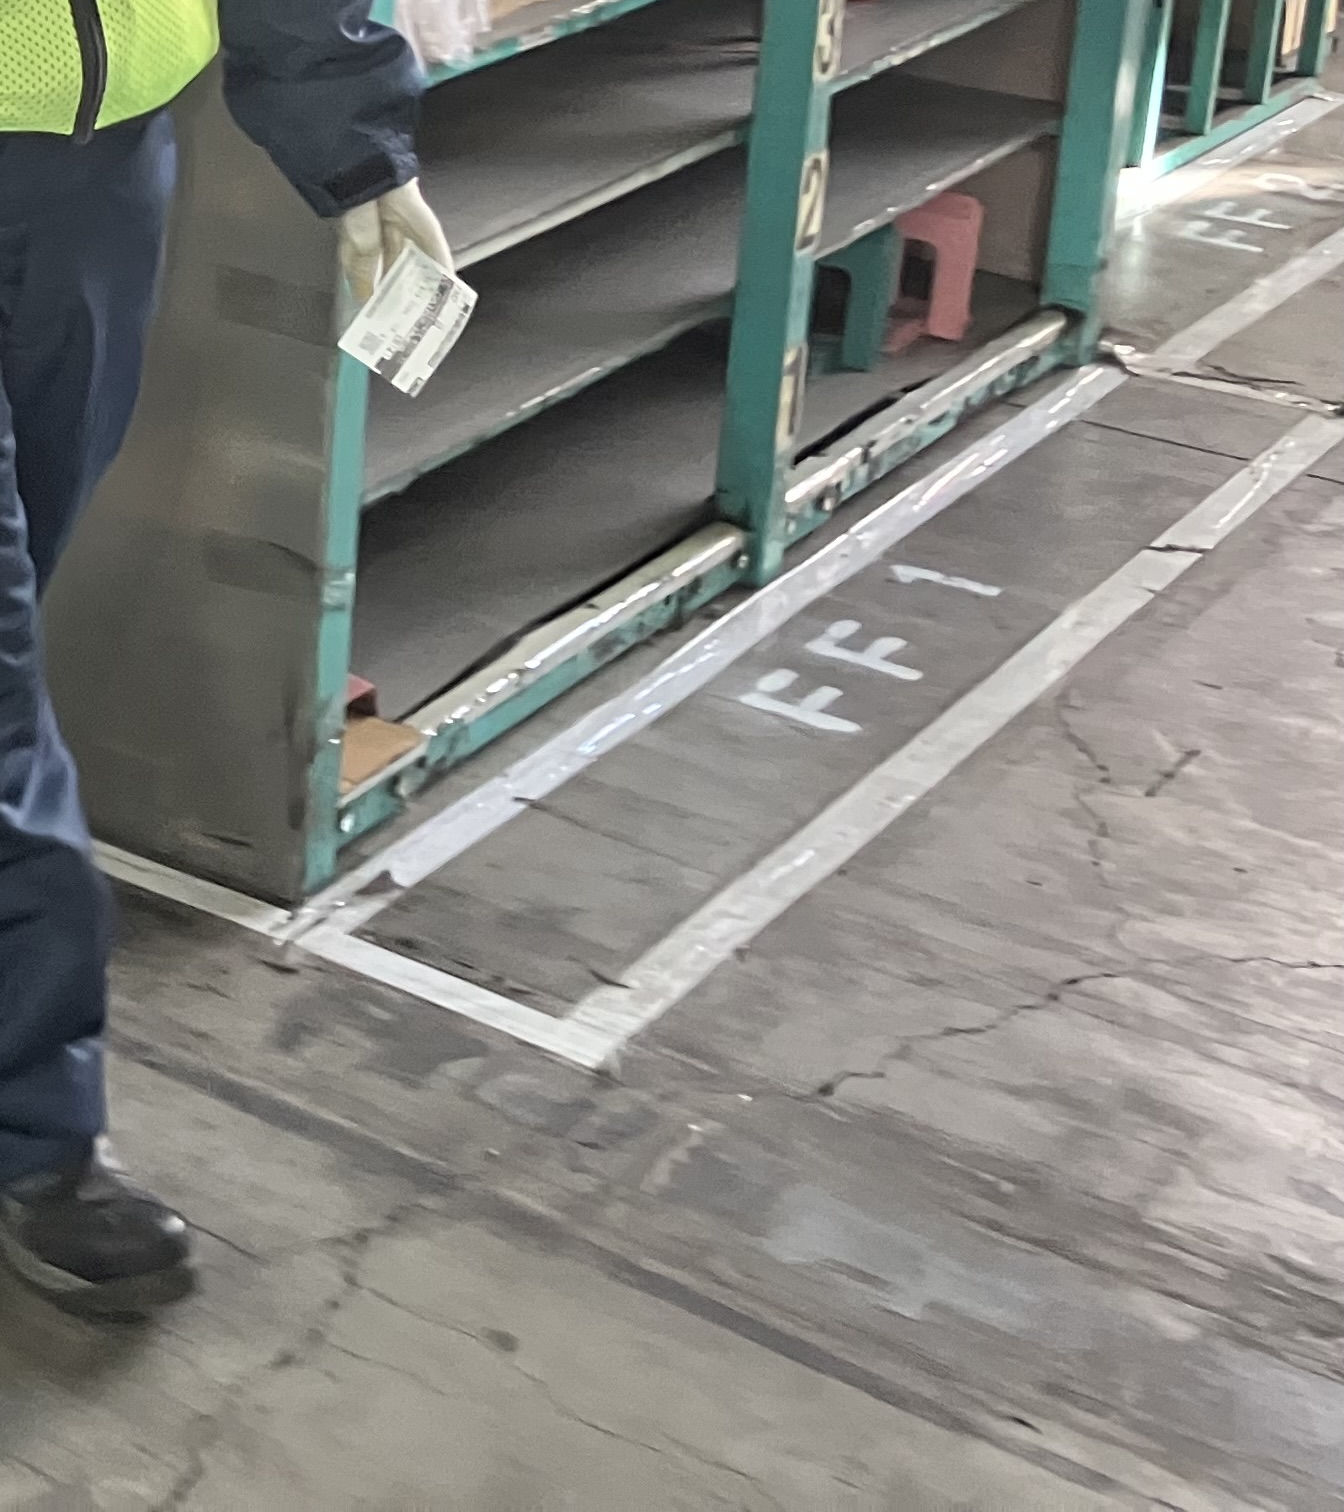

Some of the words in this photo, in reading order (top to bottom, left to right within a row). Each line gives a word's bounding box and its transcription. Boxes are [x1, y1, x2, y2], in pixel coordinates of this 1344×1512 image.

[795, 156, 822, 251] 2
[1177, 201, 1293, 253] FF
[738, 619, 924, 733] FF
[889, 564, 1003, 597] 1
